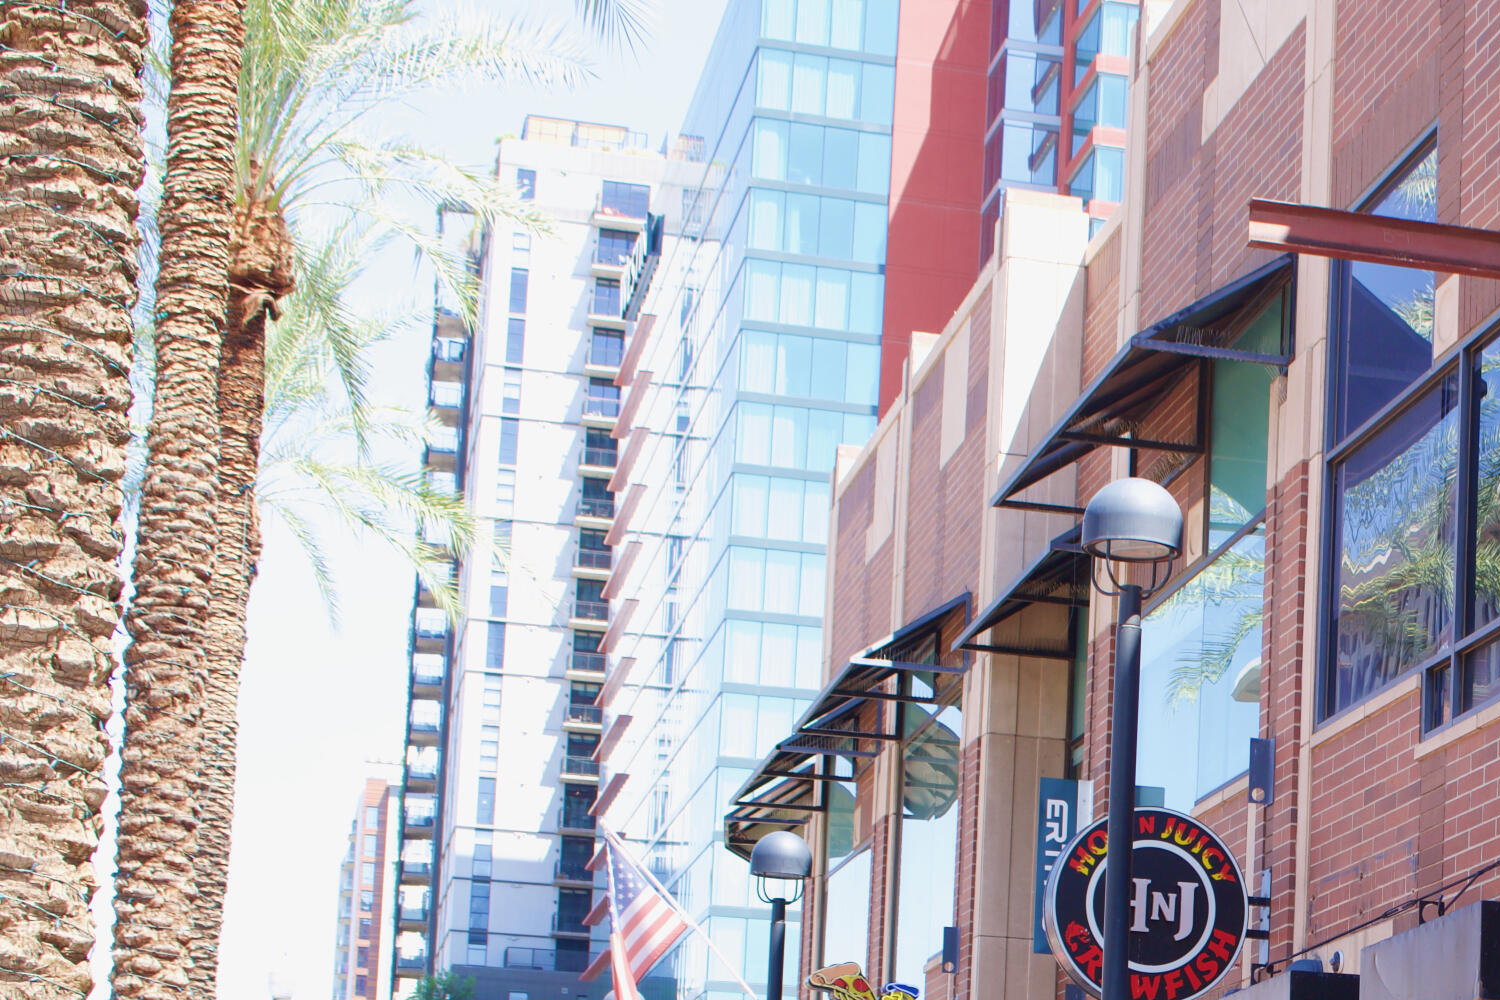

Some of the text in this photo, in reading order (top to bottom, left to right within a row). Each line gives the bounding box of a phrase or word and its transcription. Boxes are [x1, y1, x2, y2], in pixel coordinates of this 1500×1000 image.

[1069, 815, 1236, 884] HO N JUICY
